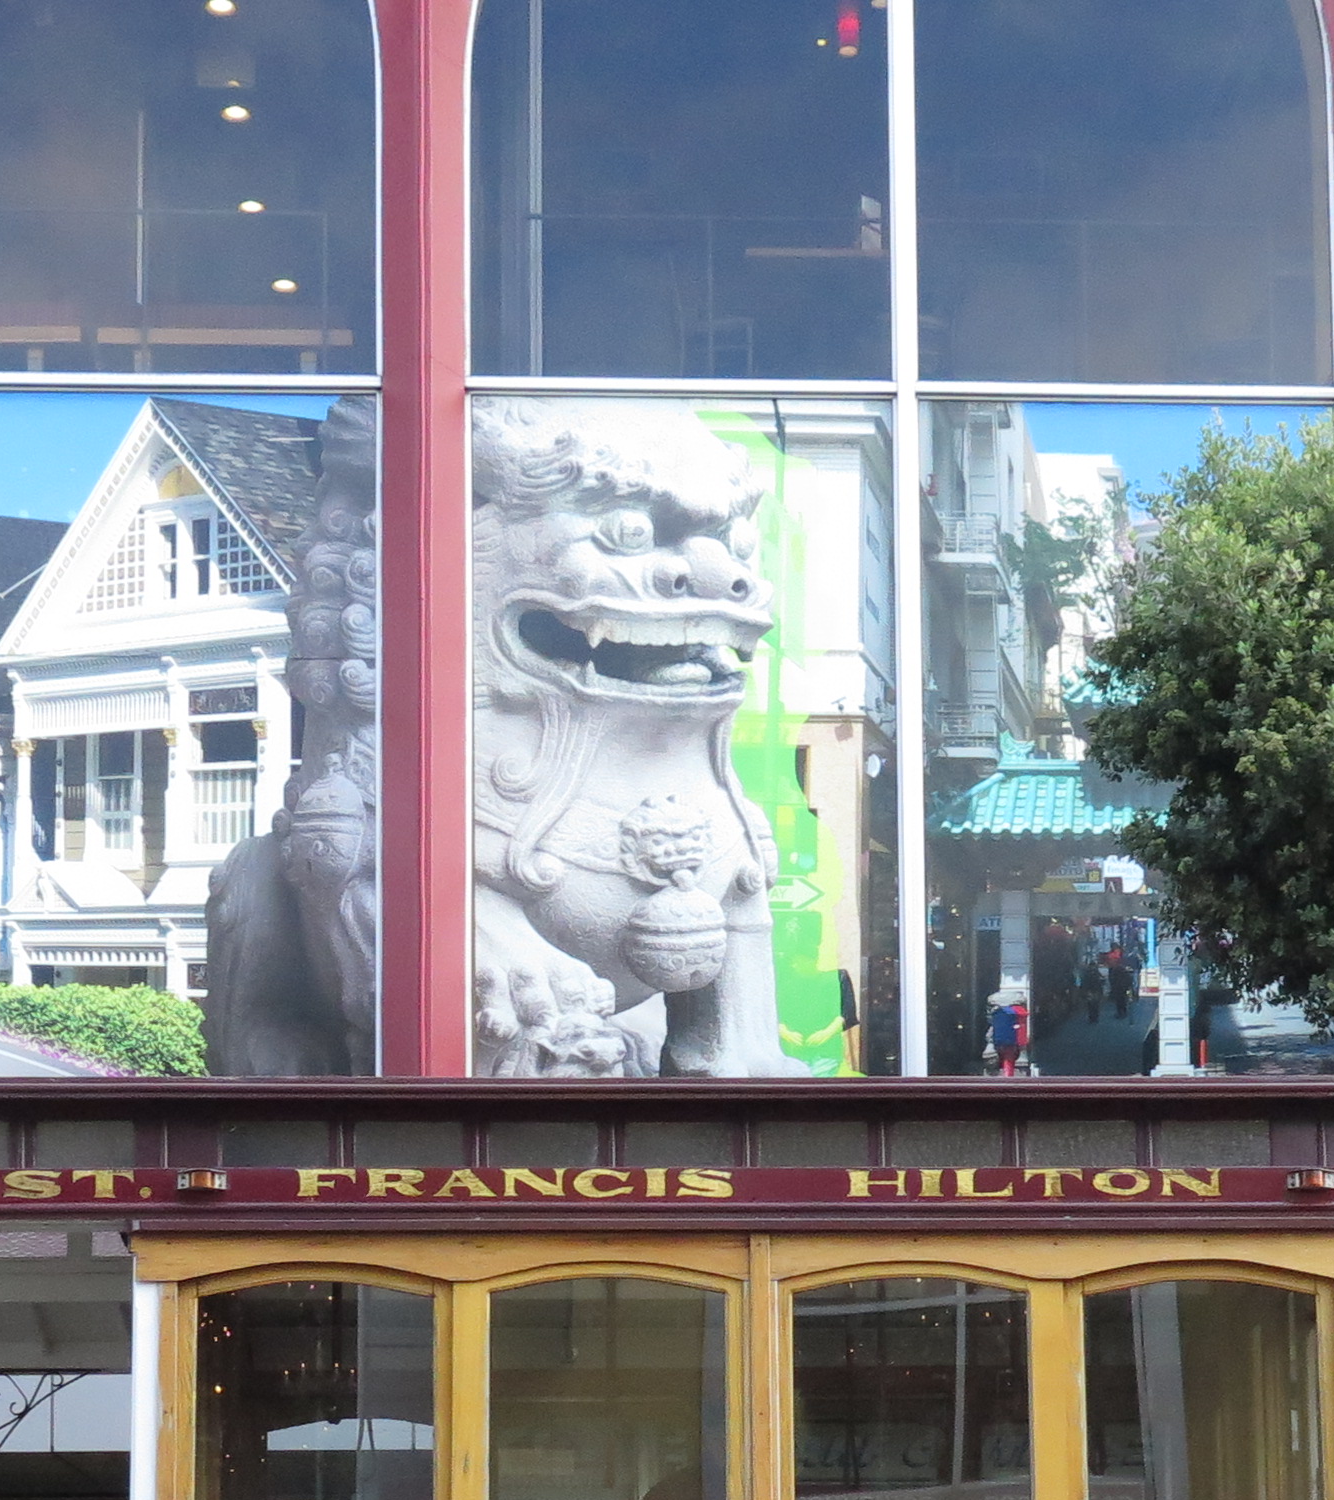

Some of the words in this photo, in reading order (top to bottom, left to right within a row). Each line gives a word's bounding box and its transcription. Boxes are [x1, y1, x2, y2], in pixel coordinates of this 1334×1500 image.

[3, 1169, 153, 1201] ST.
[295, 1168, 734, 1199] FRANCIS
[846, 1168, 1223, 1198] HILTON
